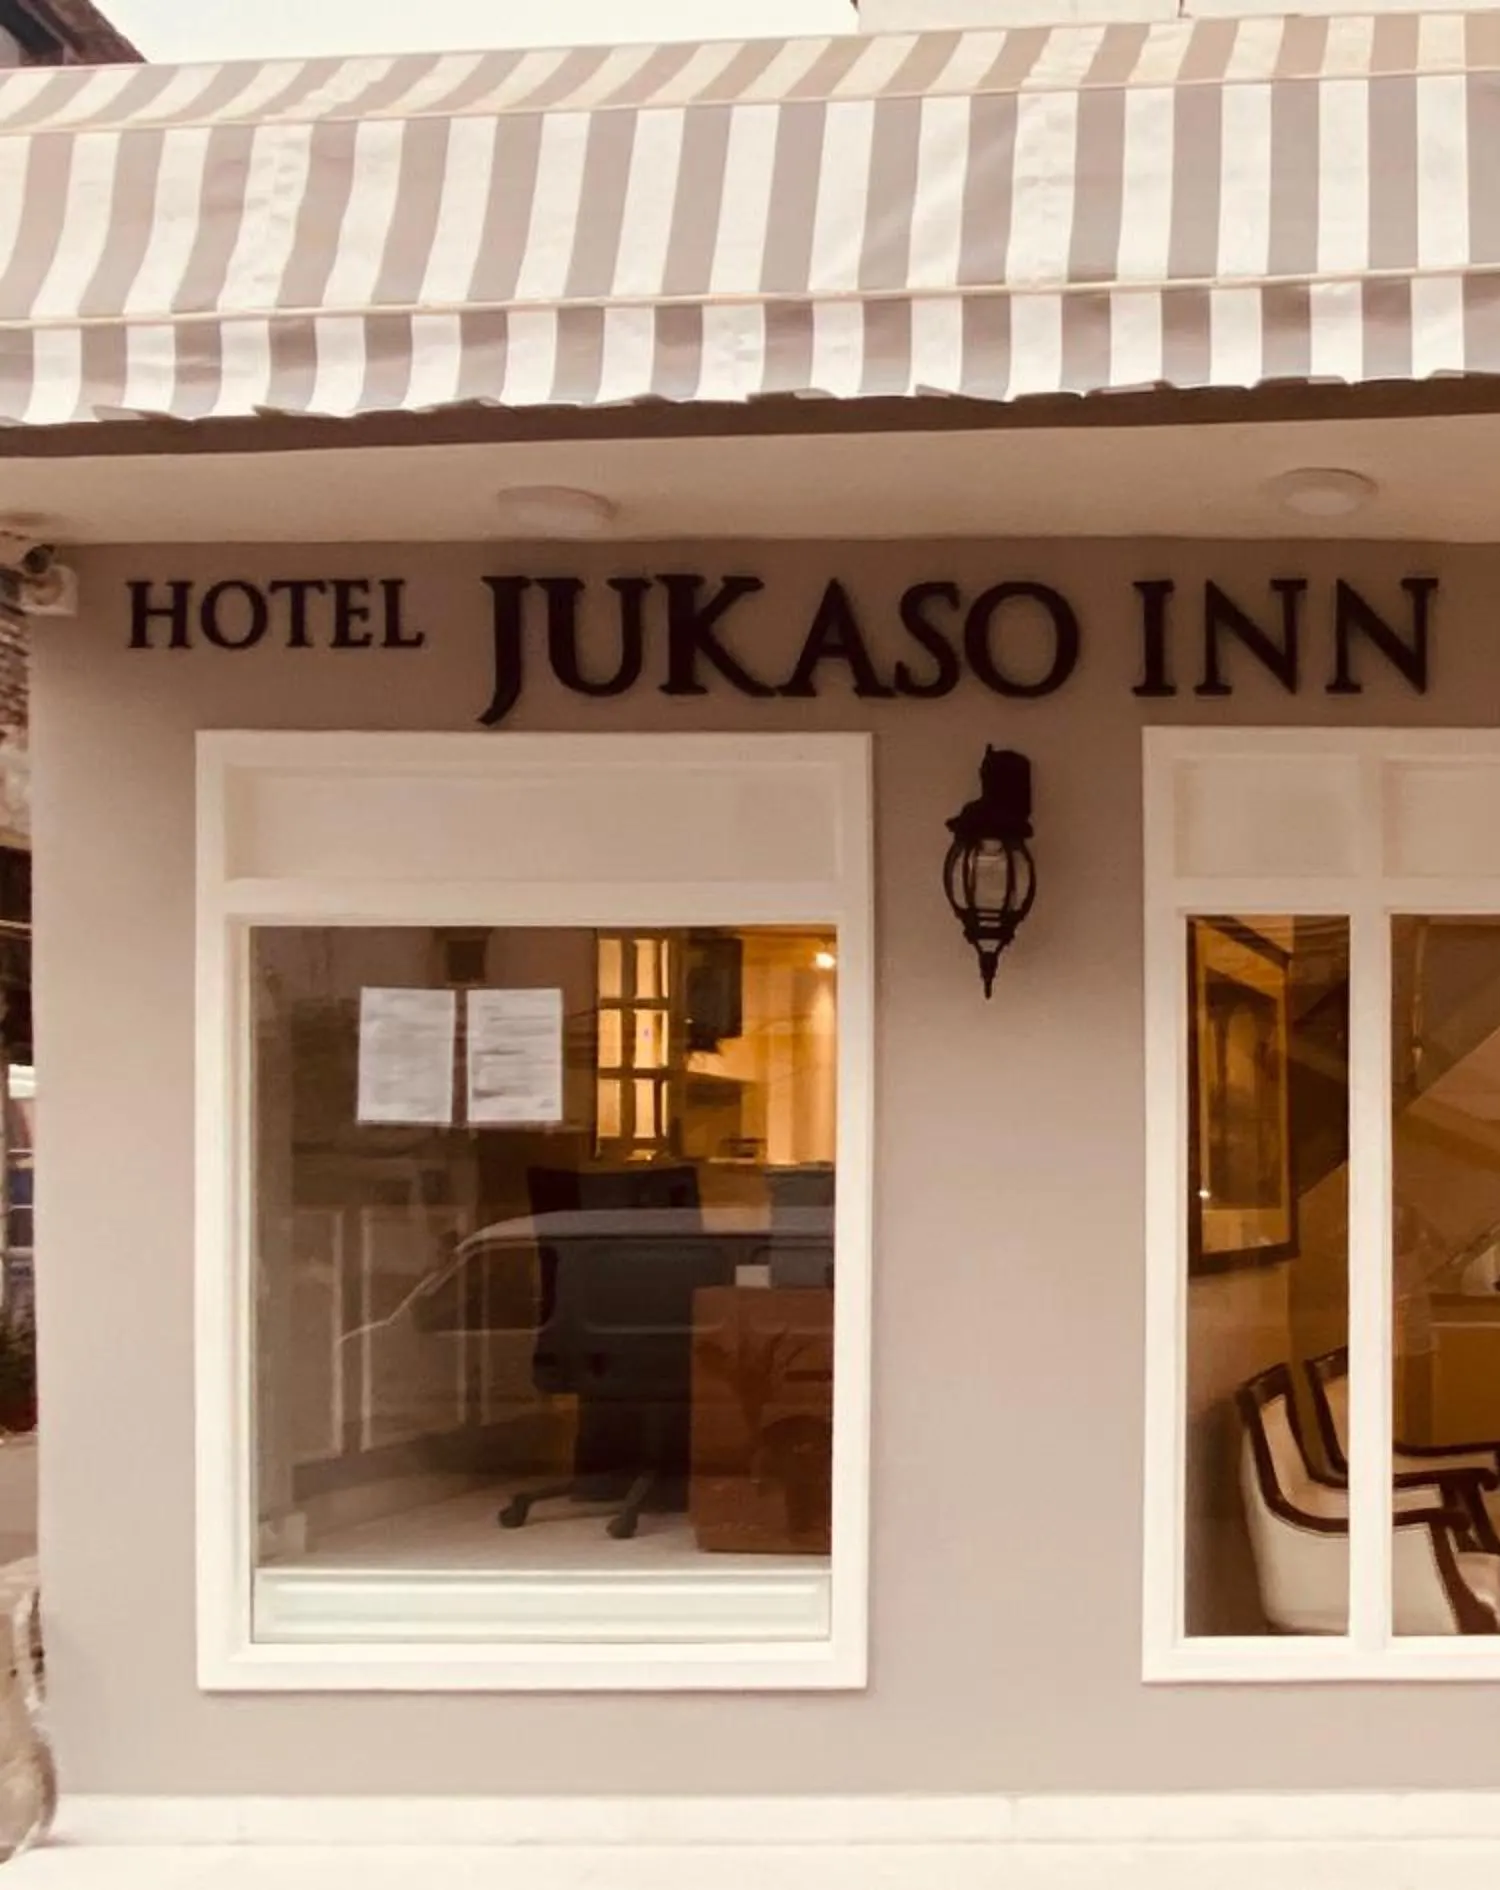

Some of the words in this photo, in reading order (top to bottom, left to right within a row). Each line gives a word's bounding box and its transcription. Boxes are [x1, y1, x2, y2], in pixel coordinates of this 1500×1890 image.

[126, 578, 425, 650] HOTEL
[477, 573, 1084, 726] JUKASO
[1131, 576, 1439, 698] INN
